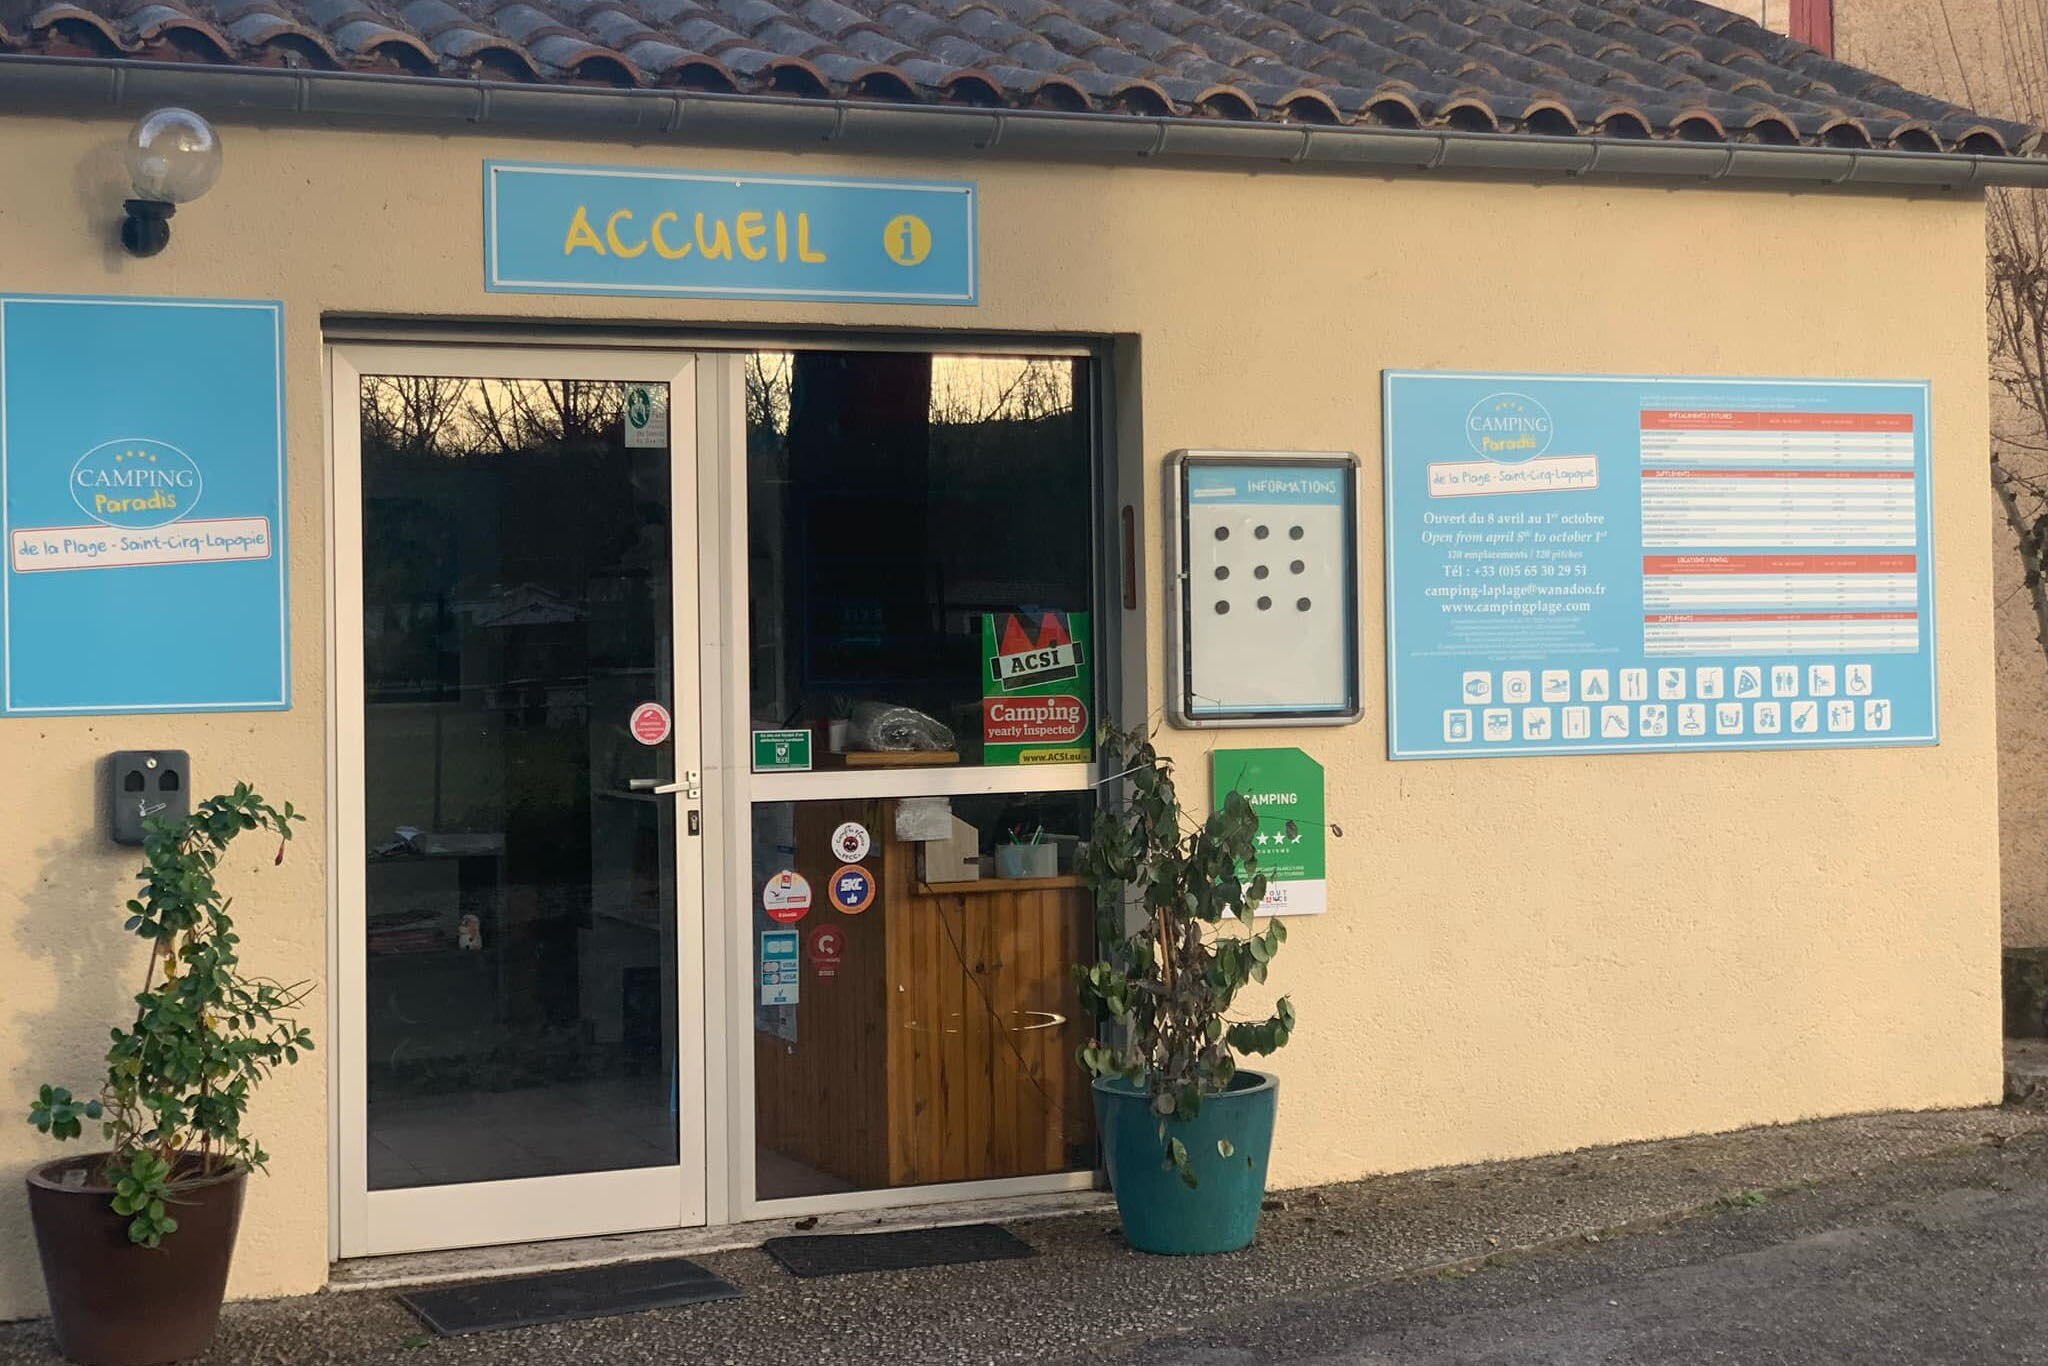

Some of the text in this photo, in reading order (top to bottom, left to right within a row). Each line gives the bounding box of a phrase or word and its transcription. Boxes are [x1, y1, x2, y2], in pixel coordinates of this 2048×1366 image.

[564, 205, 826, 264] ACCUEIL
[1471, 416, 1548, 432] CAMPING
[1482, 435, 1536, 452] Paradis
[77, 469, 193, 488] CAMPING
[1432, 472, 1446, 485] de
[1448, 472, 1458, 484] la
[1462, 470, 1491, 486] Plage
[1499, 467, 1595, 484] Saint-Cirq-Lapopie
[1247, 479, 1337, 494] INFORMATIONS
[95, 490, 178, 514] Paradis
[1423, 512, 1465, 525] Ouvert
[1469, 512, 1484, 525] du
[1488, 512, 1494, 525] 8
[1497, 512, 1524, 525] avril
[1528, 515, 1542, 525] au
[1561, 512, 1605, 525] octobre
[18, 540, 39, 556] de
[44, 540, 59, 555] la
[64, 538, 108, 558] Plage
[121, 530, 266, 556] Saint-Cirq-Lapopie
[1422, 531, 1453, 546] Open
[1454, 531, 1483, 546] from
[1486, 531, 1514, 546] april
[1534, 531, 1546, 542] to
[1549, 530, 1592, 542] october
[1464, 549, 1528, 562] emplacements
[1443, 564, 1462, 577] Tél
[1472, 564, 1495, 577] +33
[1499, 564, 1520, 577] (0)5
[1524, 564, 1537, 577] 65
[1558, 564, 1571, 577] 29
[1425, 583, 1607, 599] camping-laplage@wanadoo.fr
[1440, 600, 1590, 615] www.campingplage.com
[1011, 640, 1060, 674] ACSI
[990, 699, 1081, 723] Camping
[988, 724, 1076, 738] yearly inspected
